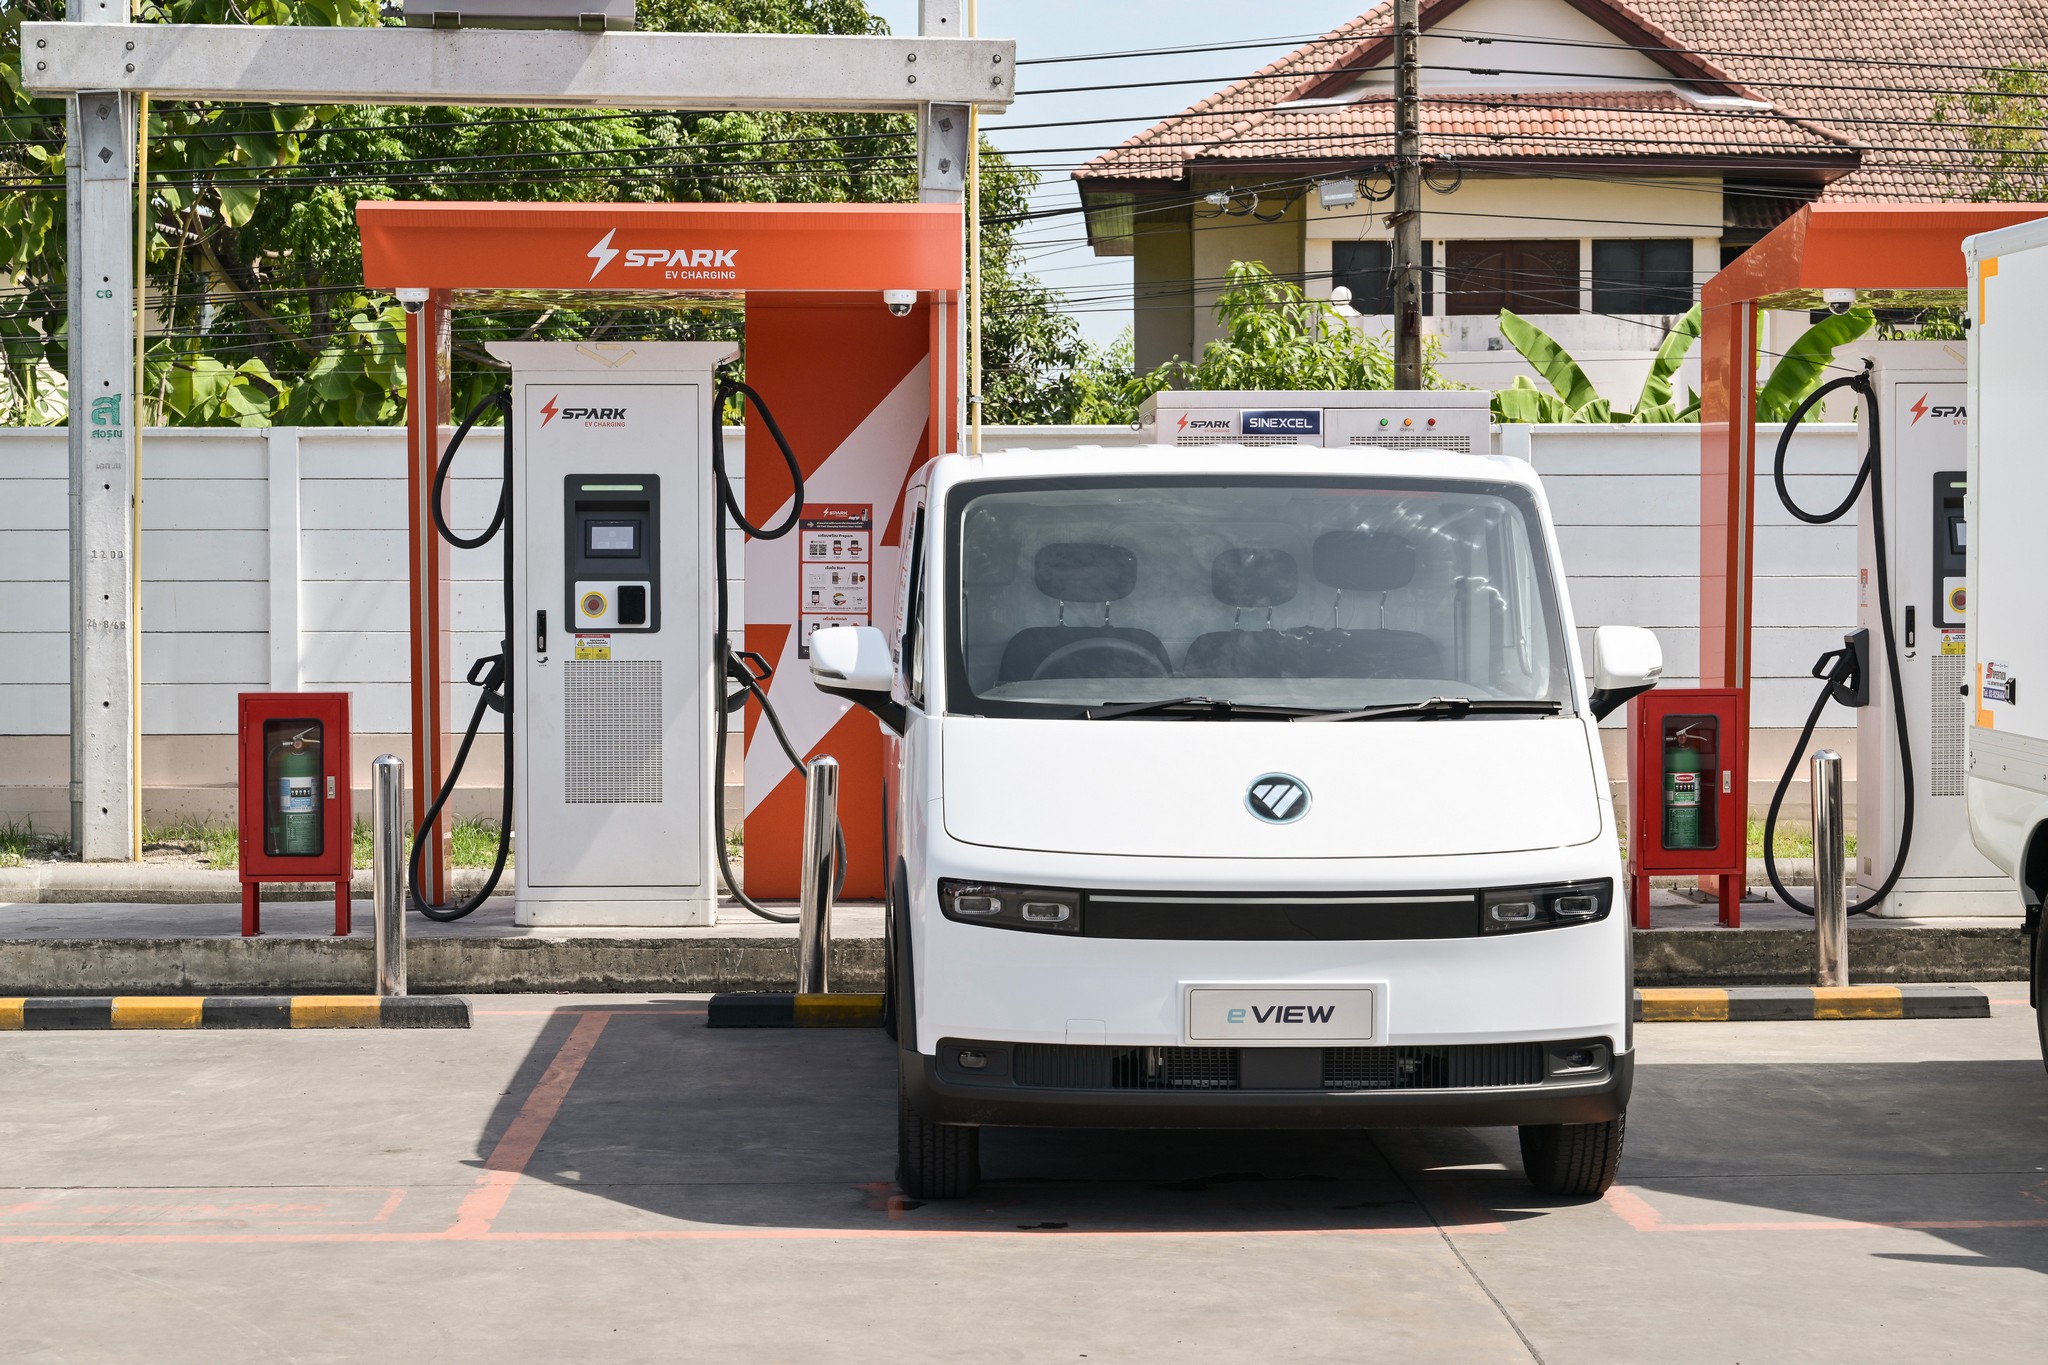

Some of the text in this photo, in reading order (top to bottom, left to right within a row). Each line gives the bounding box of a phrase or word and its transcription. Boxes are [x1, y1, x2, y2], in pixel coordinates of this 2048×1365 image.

[624, 249, 739, 267] SPARK
[665, 270, 736, 279] EV CHARGING
[561, 408, 627, 420] SPARK
[1930, 406, 1967, 417] SPA
[1249, 418, 1313, 428] SINEXCEL
[1251, 1006, 1336, 1023] VIEW
